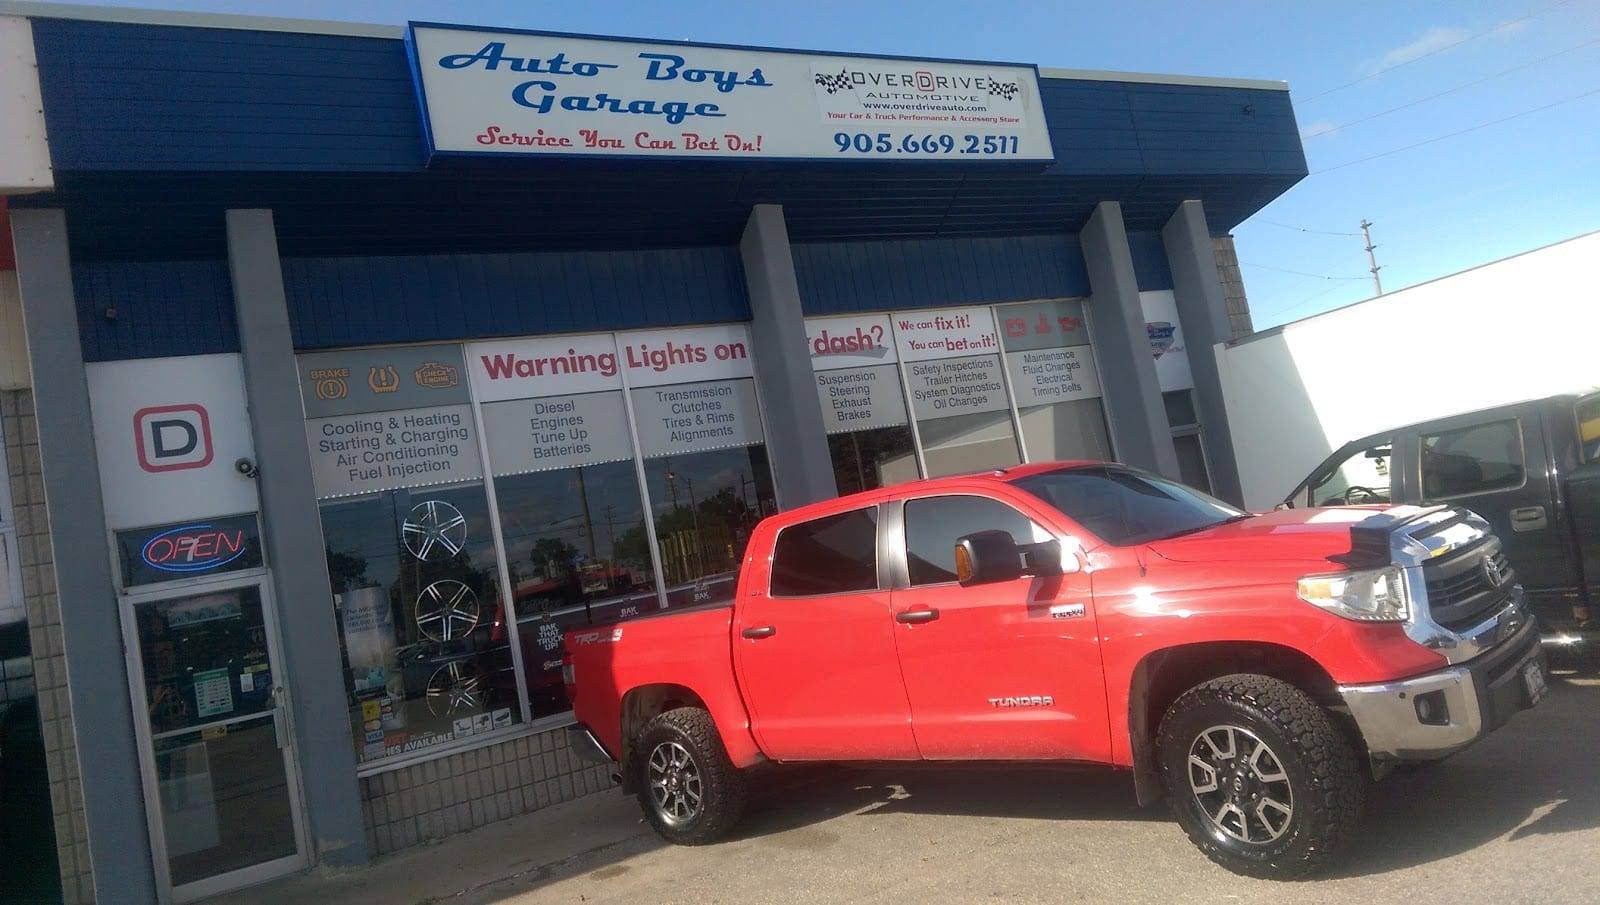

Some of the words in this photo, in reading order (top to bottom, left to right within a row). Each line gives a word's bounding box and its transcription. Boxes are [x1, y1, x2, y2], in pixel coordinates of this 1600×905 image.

[438, 41, 618, 77] Auto
[638, 53, 773, 93] Boys
[851, 72, 987, 91] OVERDRIVE
[511, 80, 727, 124] Garage
[866, 92, 979, 102] AUTOMOTIVE
[863, 102, 987, 113] www.overdriveauto.com
[827, 112, 847, 120] Your
[875, 113, 897, 121] Truck
[899, 114, 949, 122] Performance
[959, 115, 998, 123] Accessory
[476, 126, 573, 147] Service
[579, 129, 625, 149] You
[634, 132, 677, 150] Can
[681, 133, 719, 151] Bet
[723, 134, 763, 152] On!
[833, 132, 1019, 154] 905.669.2511
[898, 320, 915, 331] We
[917, 320, 933, 330] can
[935, 315, 953, 332] fix
[955, 314, 971, 330] it!
[813, 325, 884, 355] dash?
[908, 339, 927, 351] You
[928, 340, 945, 350] can
[945, 336, 968, 351] bet
[970, 340, 981, 349] on
[981, 333, 996, 348] it!
[480, 348, 618, 380] Warning
[626, 341, 708, 373] Lights
[714, 342, 747, 361] on
[1023, 351, 1075, 364] Maintenance
[310, 368, 349, 379] BRAKE
[423, 370, 448, 378] CHECK
[912, 363, 942, 377] Safety
[943, 358, 993, 375] Inspections
[1022, 362, 1048, 375] Fluid
[1049, 360, 1081, 374] Changes
[424, 375, 450, 383] ENGINE
[818, 371, 876, 385] Suspension
[924, 374, 952, 387] Trailer
[955, 370, 988, 383] Hitches
[1036, 373, 1073, 385] Electrical
[656, 386, 733, 402] Transmission
[829, 383, 870, 397] Steering
[914, 387, 948, 401] System
[950, 381, 1001, 397] Diagnostics
[1032, 385, 1059, 398] Timing
[1060, 382, 1082, 394] Belts
[534, 401, 576, 415] Diesel
[671, 400, 722, 415] Clutches
[832, 396, 872, 410] Exhaust
[933, 397, 948, 410] Oil
[949, 393, 988, 408] Changes
[530, 414, 584, 431] Engines
[663, 416, 692, 429] Tires
[695, 413, 704, 425] &
[707, 412, 735, 424] Rims
[837, 408, 872, 422] Brakes
[322, 421, 383, 437] Cooling
[388, 417, 400, 430] &
[403, 413, 461, 428] Heating
[151, 419, 198, 459] D
[319, 437, 381, 453] Starting
[385, 433, 397, 446] &
[401, 428, 469, 444] Charging
[532, 431, 565, 445] Tune
[571, 429, 588, 443] Up
[670, 425, 734, 443] Alignments
[336, 454, 358, 467] Air
[363, 443, 459, 464] Conditioning
[533, 443, 592, 460] Batteries
[349, 466, 382, 482] Fuel
[388, 460, 451, 478] Injection
[148, 530, 242, 563] OPEN
[988, 695, 1054, 707] TUNDRA
[404, 732, 454, 752] AVAILABLE
